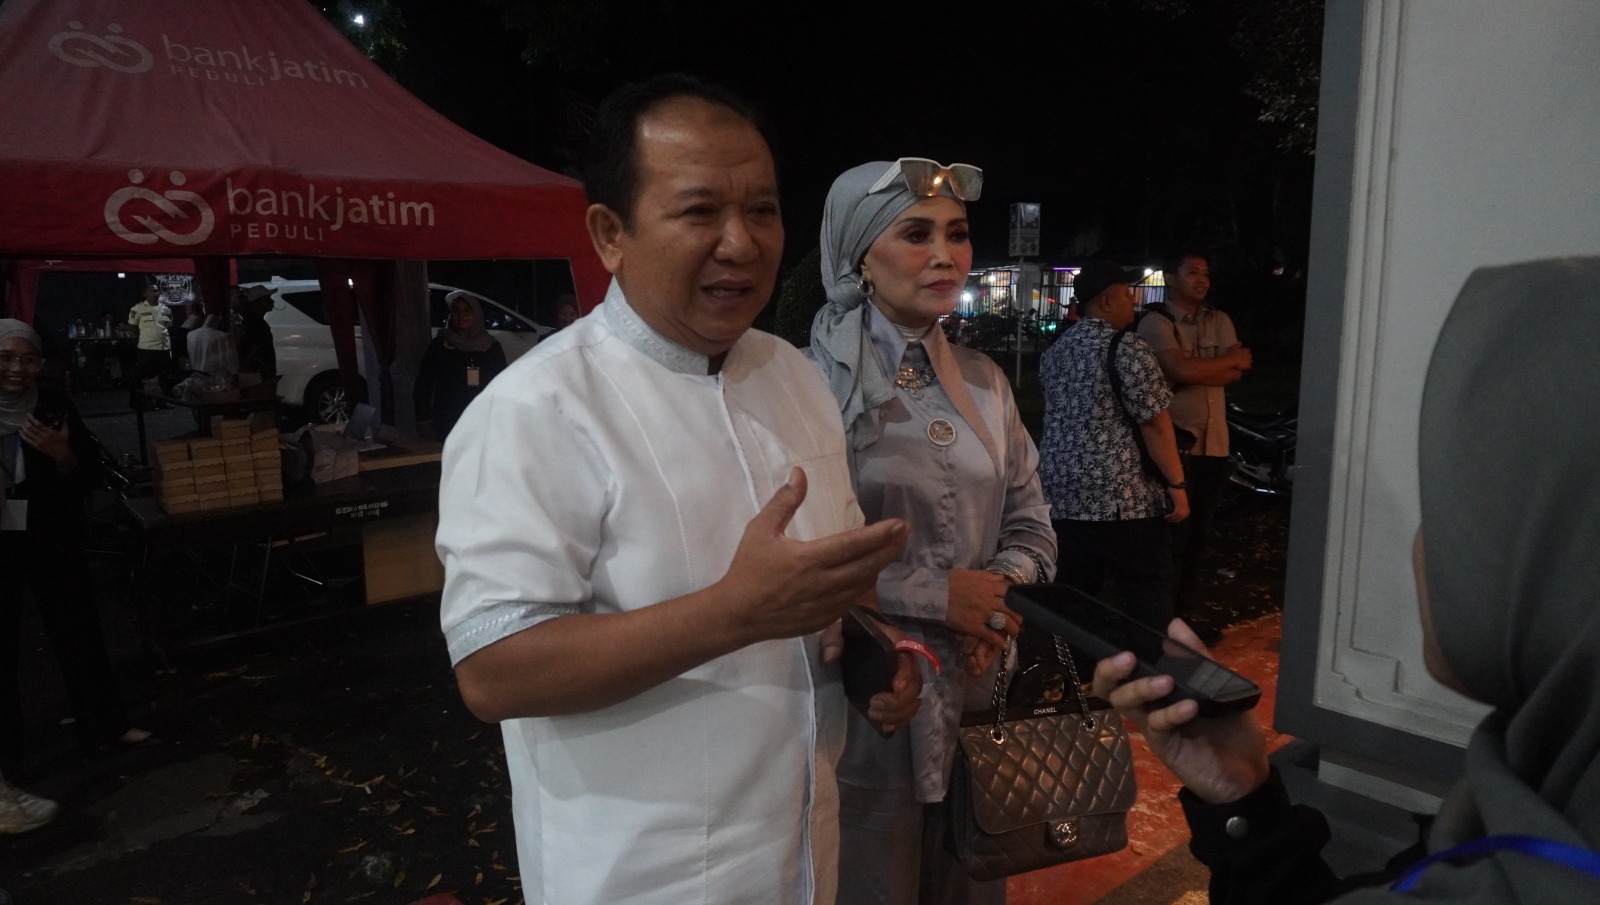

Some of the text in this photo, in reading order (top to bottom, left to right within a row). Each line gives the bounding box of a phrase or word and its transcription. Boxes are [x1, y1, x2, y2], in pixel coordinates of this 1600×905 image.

[170, 65, 264, 86] PEDULI
[230, 223, 324, 241] PEDULI
[1033, 706, 1058, 715] CHANEL
